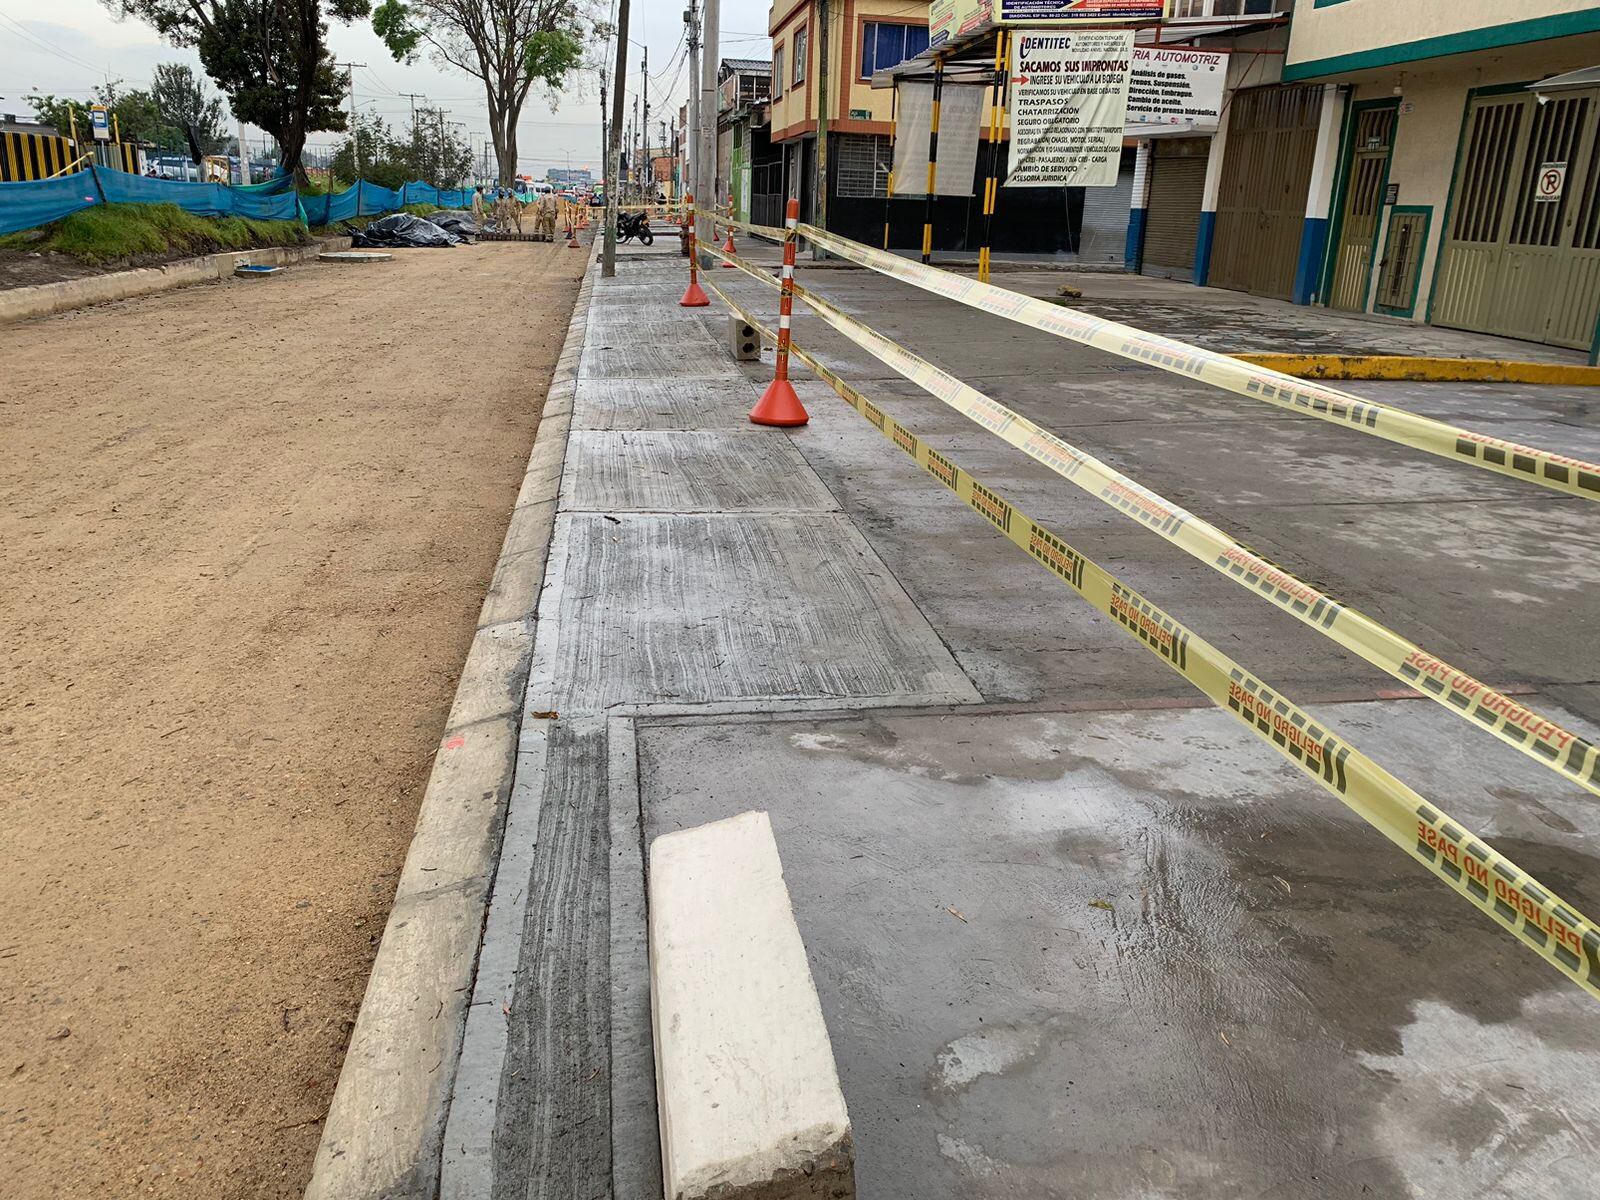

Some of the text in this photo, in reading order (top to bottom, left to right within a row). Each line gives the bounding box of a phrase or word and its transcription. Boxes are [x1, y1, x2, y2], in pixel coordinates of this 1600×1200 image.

[1153, 52, 1221, 65] AUTOMOTRIZ
[1019, 60, 1129, 73] SACAMOS SUS IMPRONTAS
[1029, 75, 1053, 85] INGRESE
[1055, 75, 1061, 84] SU
[1102, 74, 1124, 84] BODEGA
[1131, 69, 1186, 80] Análisis de gases.
[1161, 89, 1194, 98] Embrague.
[1018, 98, 1069, 106] TRASPASOS
[1127, 95, 1182, 106] Cambio de aceite.
[1126, 104, 1153, 112] Servicio
[1153, 105, 1162, 113] de
[1162, 107, 1185, 115] prensa
[1017, 118, 1042, 126] SEGURO
[1012, 174, 1040, 182] ASESORIA
